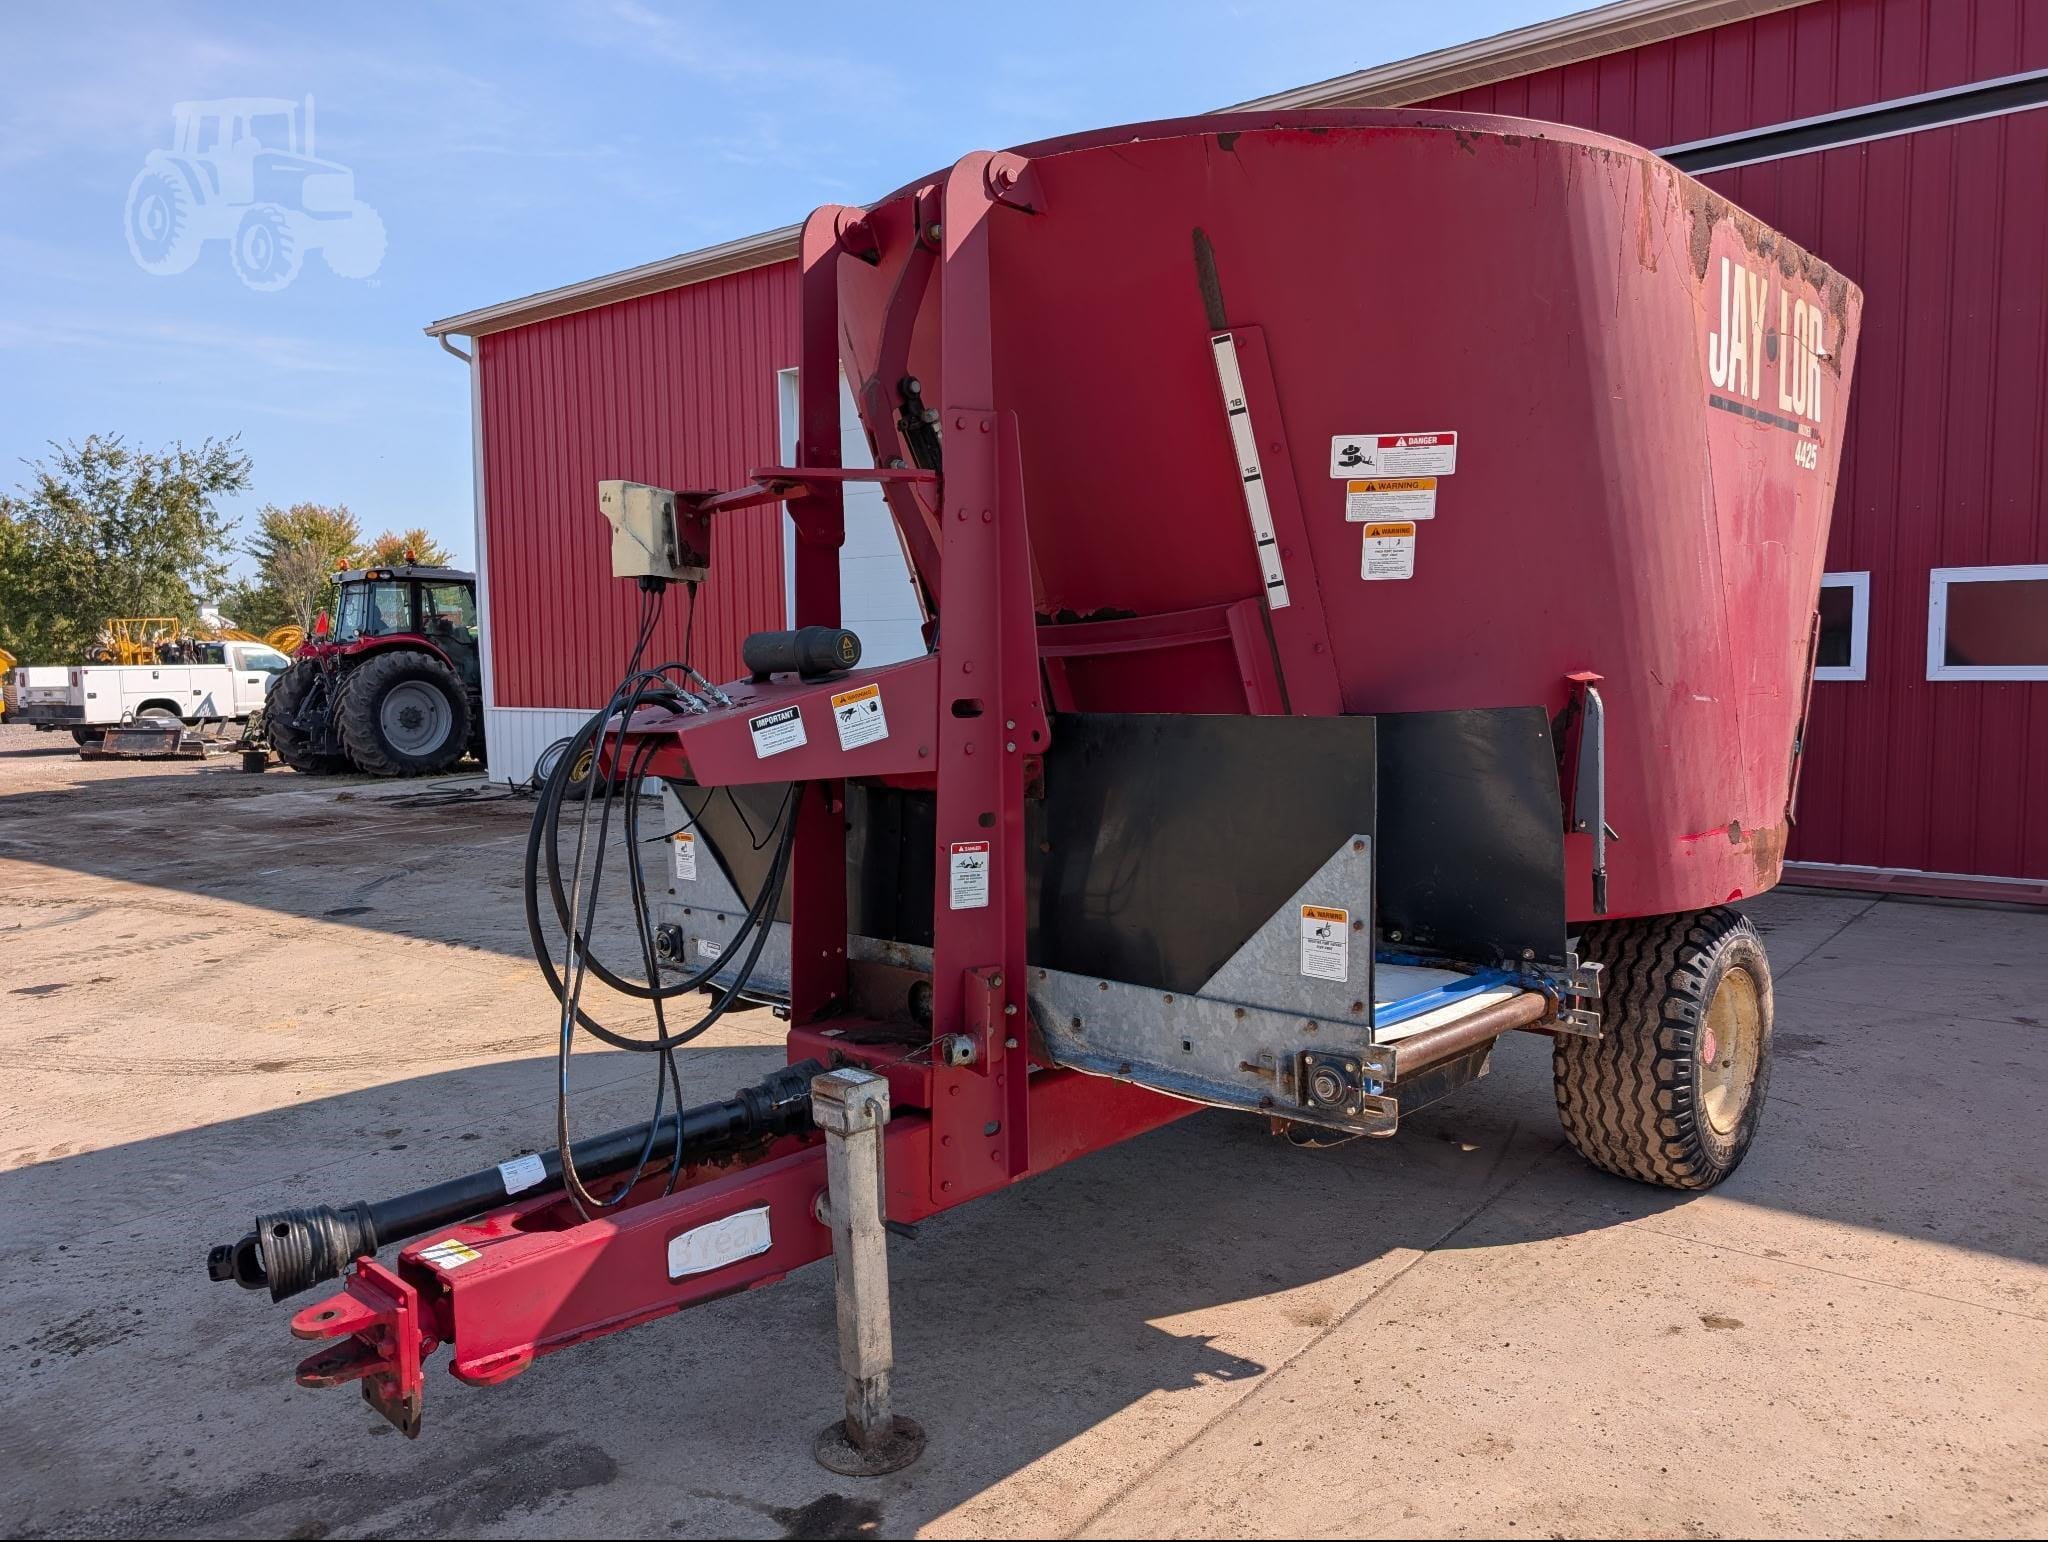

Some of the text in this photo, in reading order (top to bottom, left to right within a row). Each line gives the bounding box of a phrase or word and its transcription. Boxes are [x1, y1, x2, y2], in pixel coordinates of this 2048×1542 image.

[1708, 256, 1768, 400] JAY
[1229, 398, 1243, 408] 18
[1408, 436, 1438, 446] DANGER
[1794, 439, 1818, 471] 4425
[1244, 466, 1257, 474] 12
[1377, 481, 1420, 491] WARNING
[1381, 527, 1411, 535] WARNING
[755, 709, 794, 729] IMPORTANT
[1316, 911, 1343, 921] WARNING
